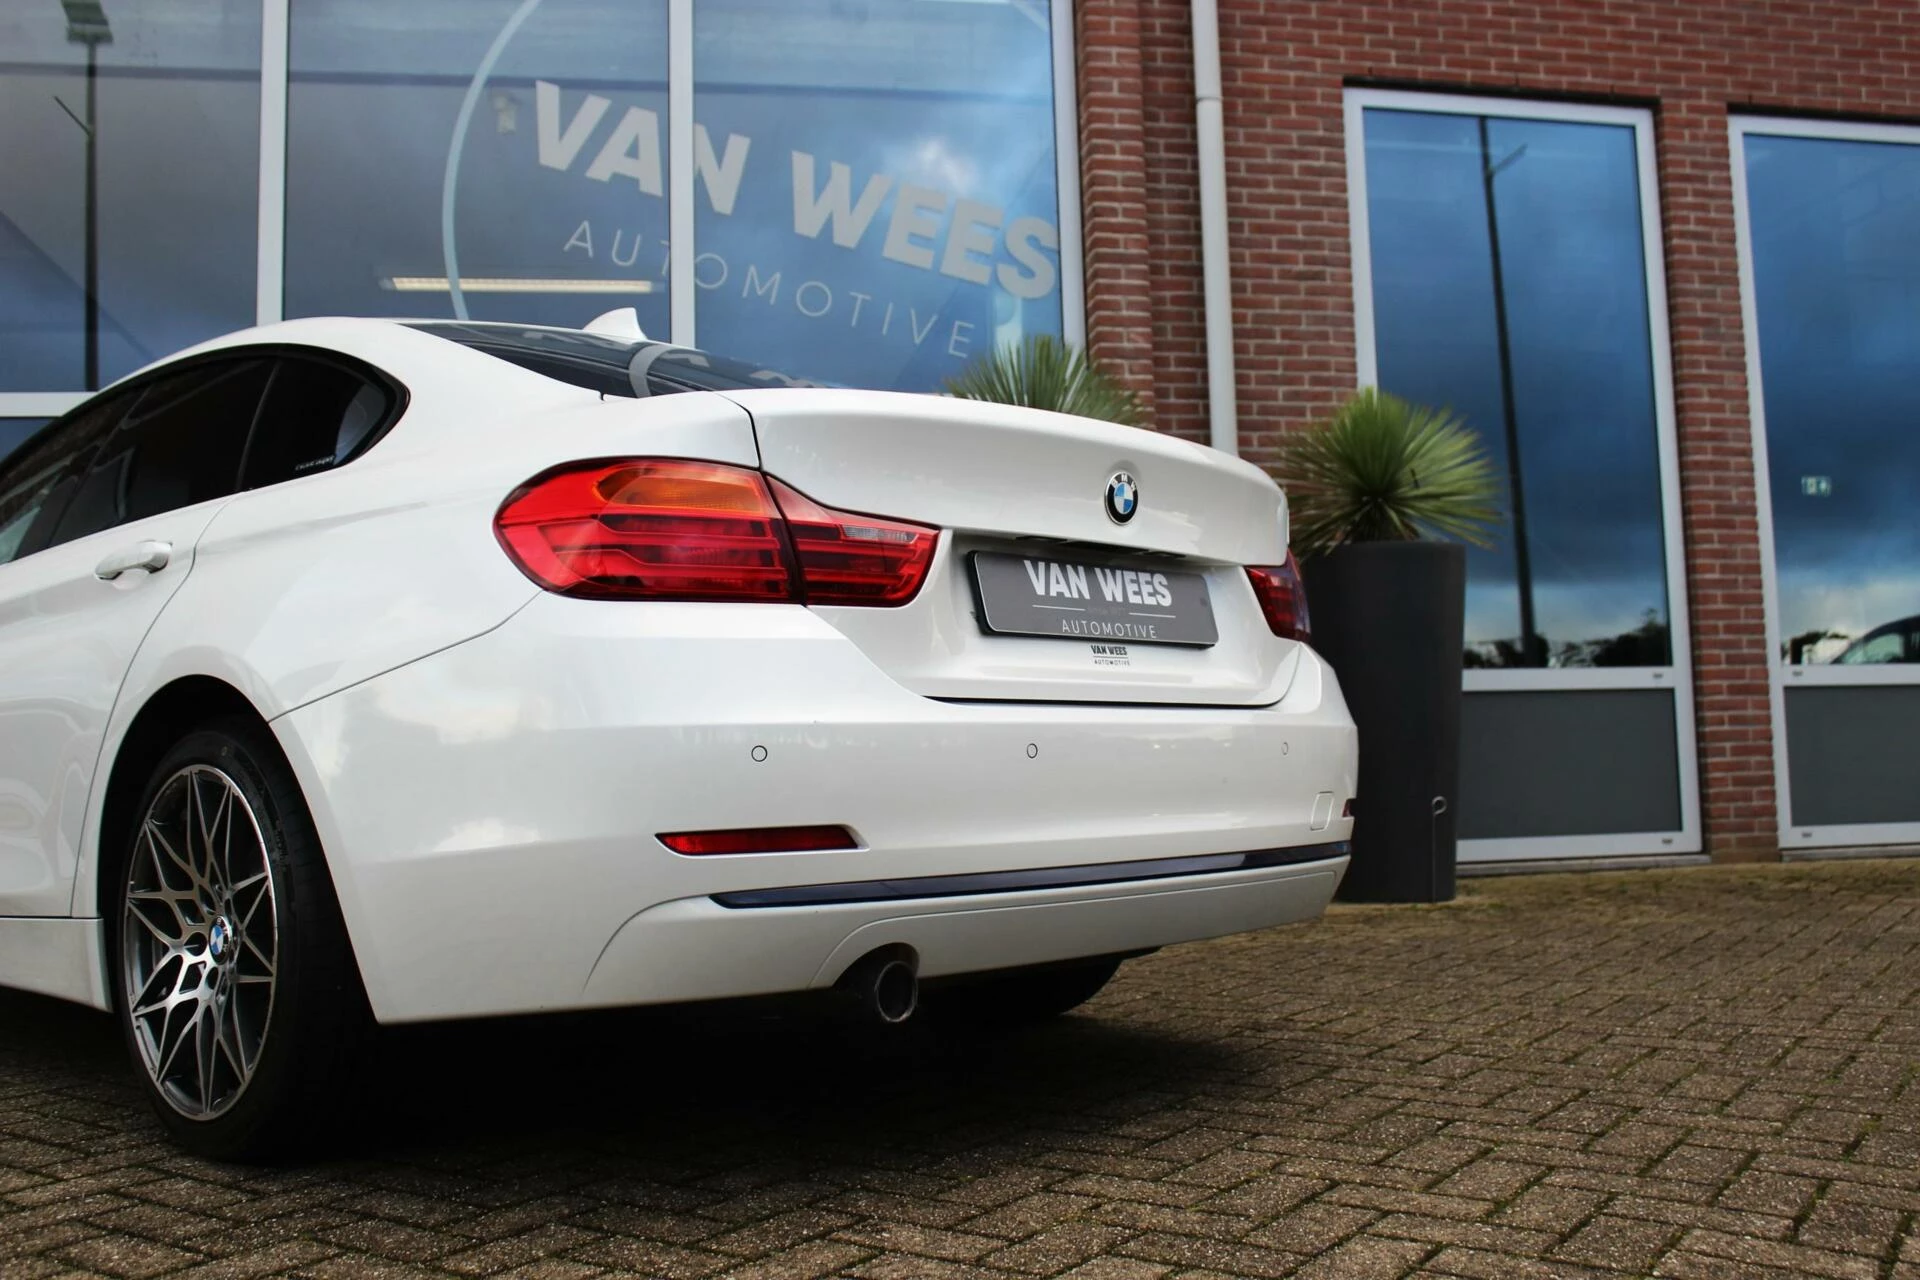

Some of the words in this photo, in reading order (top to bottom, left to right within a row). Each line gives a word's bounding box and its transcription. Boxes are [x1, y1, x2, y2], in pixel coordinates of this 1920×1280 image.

[536, 80, 750, 216] VAN
[791, 150, 1058, 299] WEES
[1110, 472, 1137, 491] BMW
[1023, 560, 1090, 600] VAN
[1094, 567, 1172, 607] WEES
[1063, 619, 1157, 639] AUTOMOTIVE
[1090, 644, 1107, 655] VAN
[1107, 646, 1128, 656] WEES
